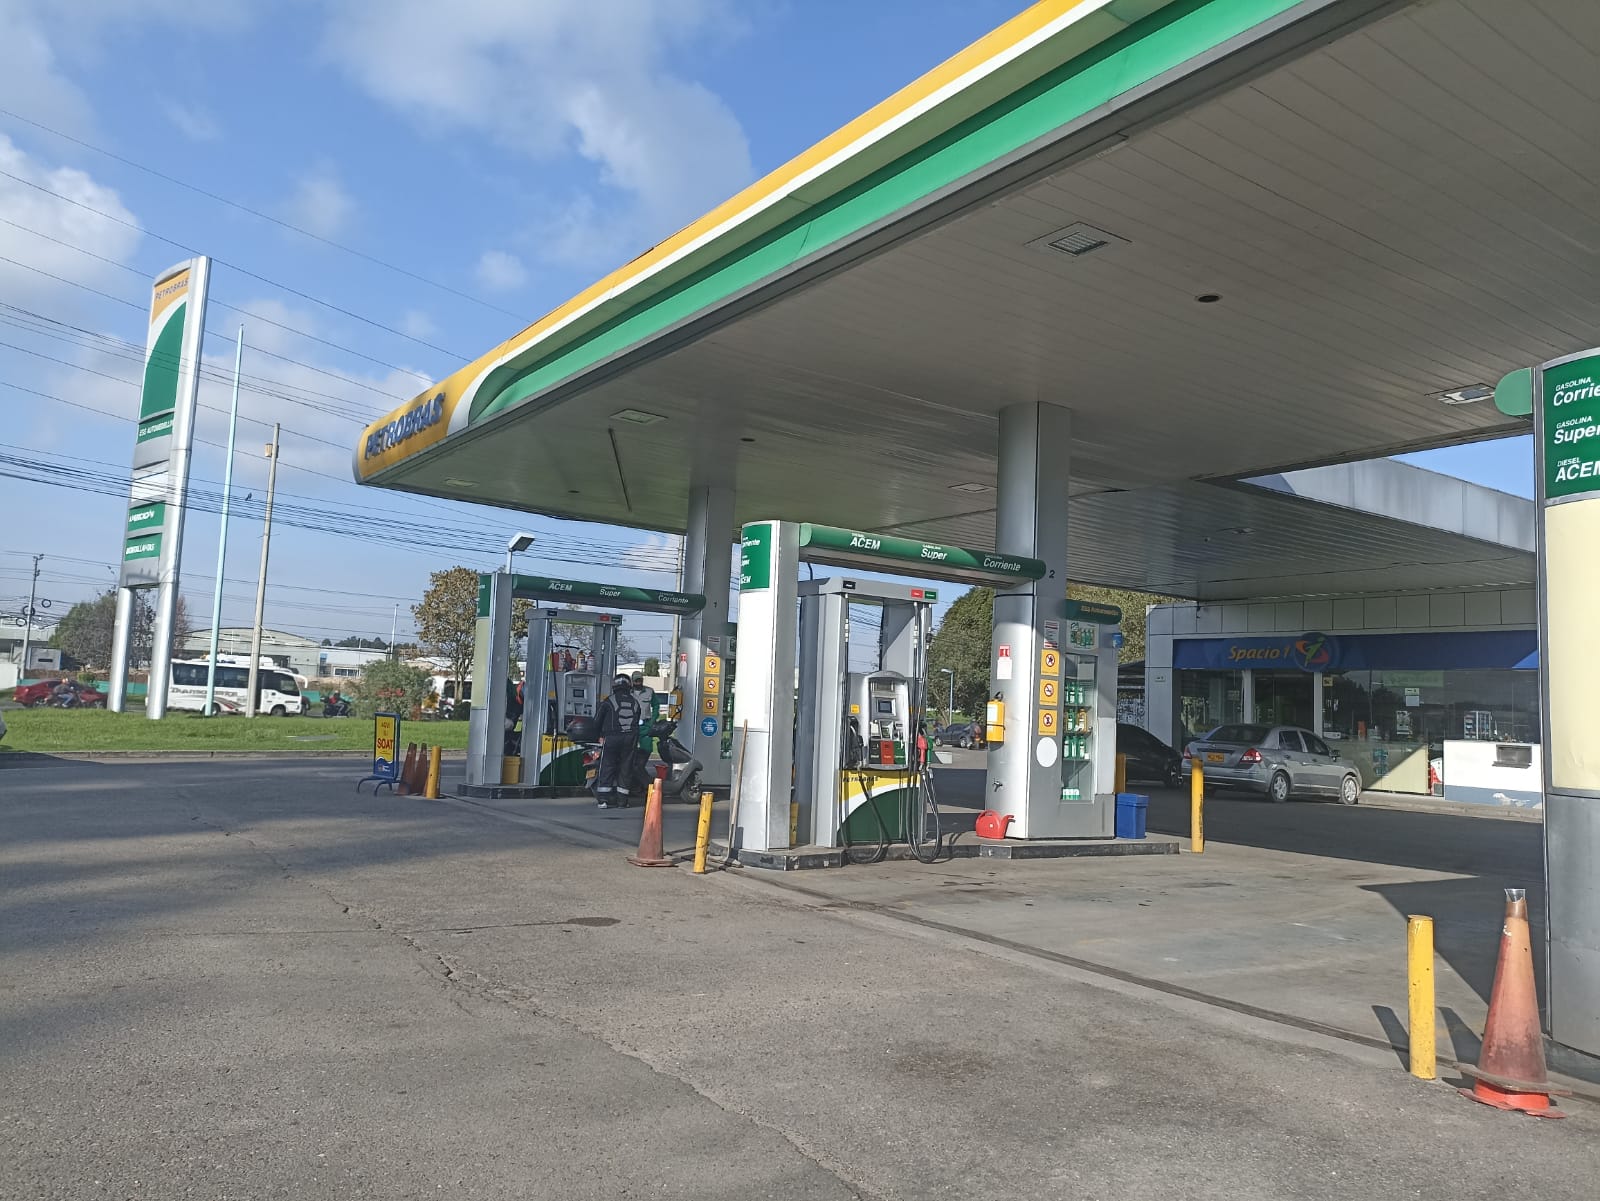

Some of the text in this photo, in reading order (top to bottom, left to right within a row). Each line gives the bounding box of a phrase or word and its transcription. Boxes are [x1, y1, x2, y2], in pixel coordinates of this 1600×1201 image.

[155, 277, 189, 300] PETROBRAS
[1555, 376, 1592, 392] GASOLINA
[365, 392, 446, 460] PETROBRAS
[1556, 415, 1593, 429] GASOLINA
[1553, 424, 1600, 444] Super
[1557, 457, 1581, 467] DIESEL
[850, 536, 881, 550] ACEM
[920, 548, 948, 560] Super
[983, 557, 1021, 571] Corriente
[1048, 569, 1056, 579] 2
[548, 582, 573, 592] ACEM
[599, 588, 622, 598] Super
[658, 594, 690, 604] Corriente
[1227, 646, 1281, 662] Spacio
[376, 738, 394, 750] SOAT
